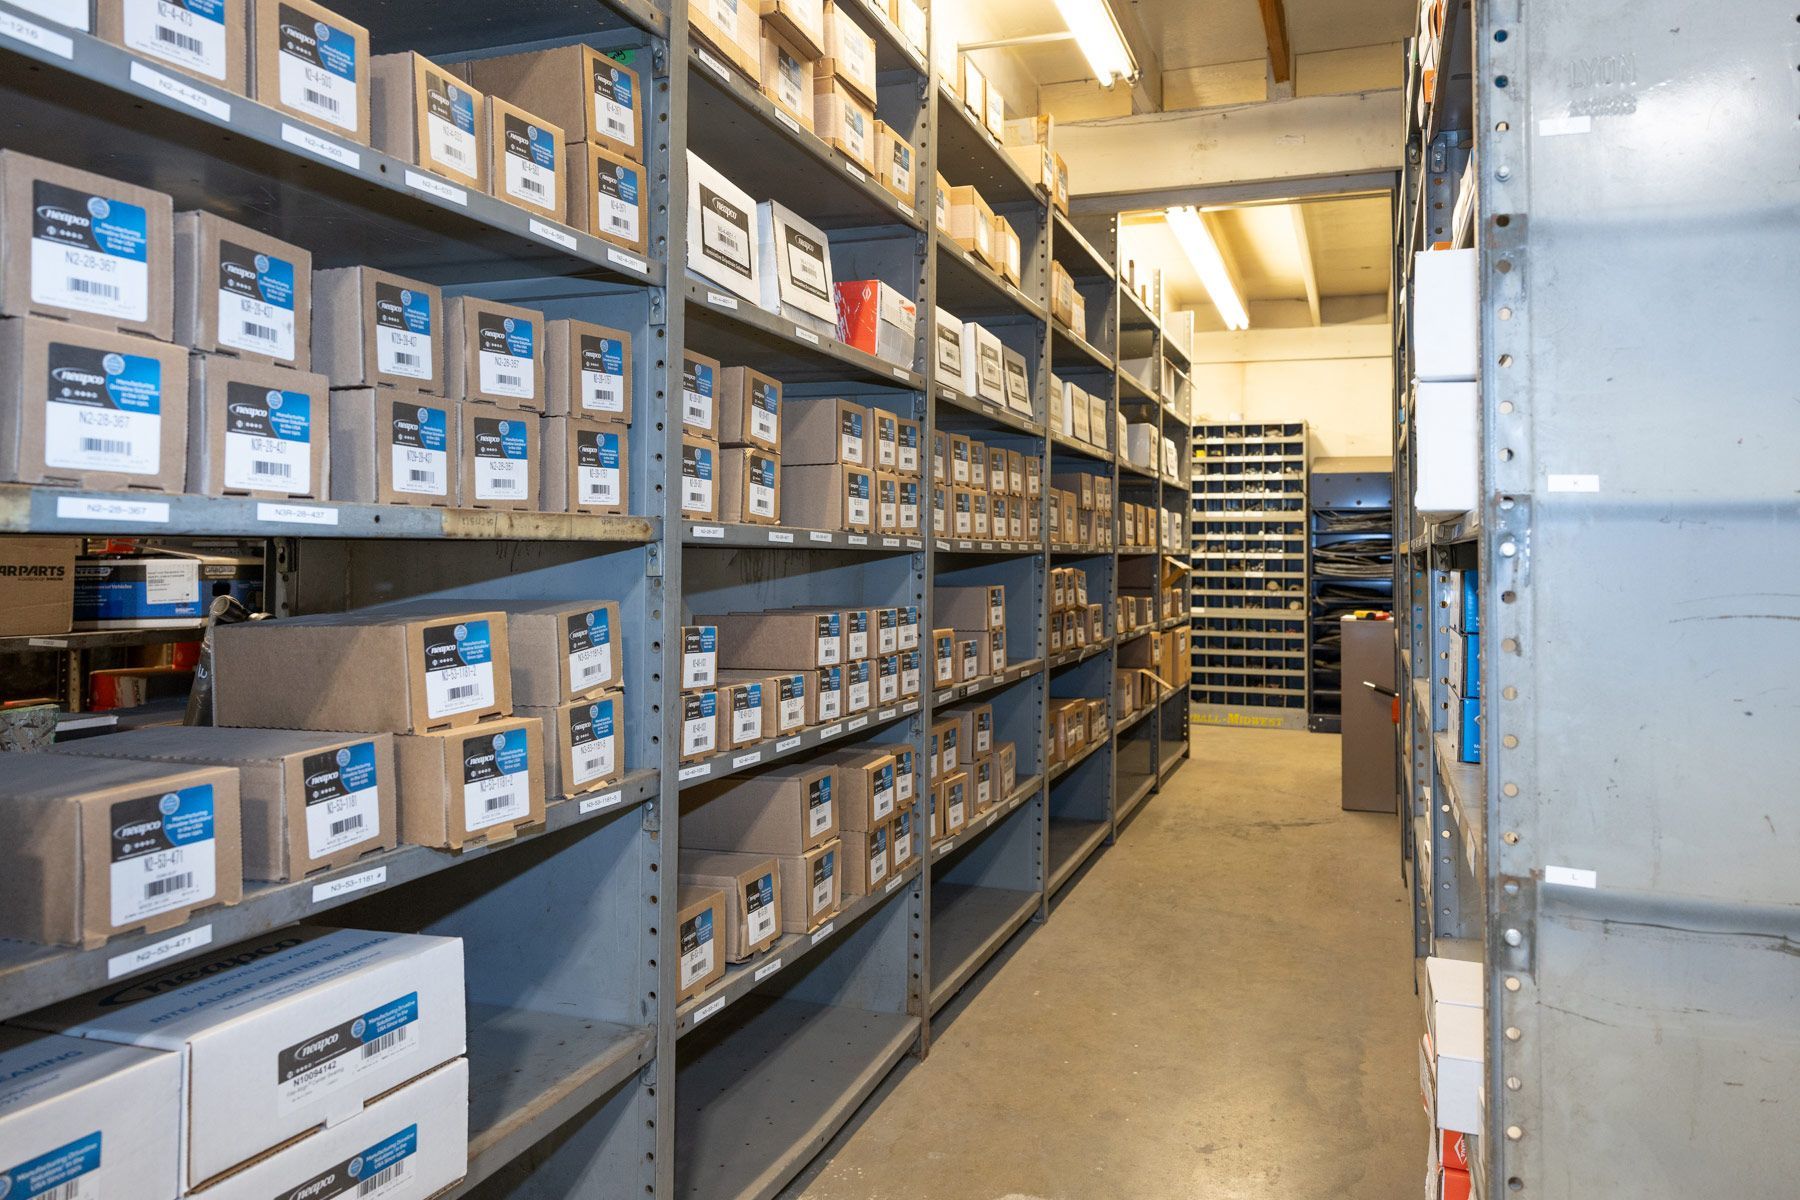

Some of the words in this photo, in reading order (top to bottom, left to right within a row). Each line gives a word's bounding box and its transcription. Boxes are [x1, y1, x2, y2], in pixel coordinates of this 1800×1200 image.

[286, 26, 316, 46] neapco
[1568, 53, 1637, 88] LYON
[510, 133, 529, 146] neapco
[45, 208, 90, 227] neapco
[716, 200, 737, 220] neapco
[798, 237, 814, 252] neapco
[227, 264, 256, 279] neapco
[381, 301, 403, 313] neapco
[484, 329, 506, 340] neapco
[586, 350, 602, 360] neapco
[61, 369, 105, 386] neapco
[235, 405, 268, 418] neapco
[398, 421, 419, 432] neapco
[479, 433, 501, 445] neapco
[581, 445, 598, 454] neapco
[572, 629, 587, 639] neapco
[430, 644, 456, 655] neapco
[574, 720, 591, 731] neapco
[470, 753, 494, 765] neapco
[311, 771, 339, 786] neapco
[326, 795, 358, 815] N3-53-1181
[121, 820, 162, 837] neapco
[144, 850, 184, 872] N2-53-471
[330, 874, 374, 893] N3-53-1181
[136, 937, 192, 962] N2-53-471
[130, 937, 303, 997] neapco
[258, 959, 320, 988] CENTER
[323, 937, 388, 967] BEARING
[302, 1033, 339, 1057] neapco
[293, 1060, 337, 1087] N10094142
[16, 1155, 68, 1182] Manufacturing
[30, 1179, 46, 1192] USA
[297, 1174, 335, 1199] neapco
